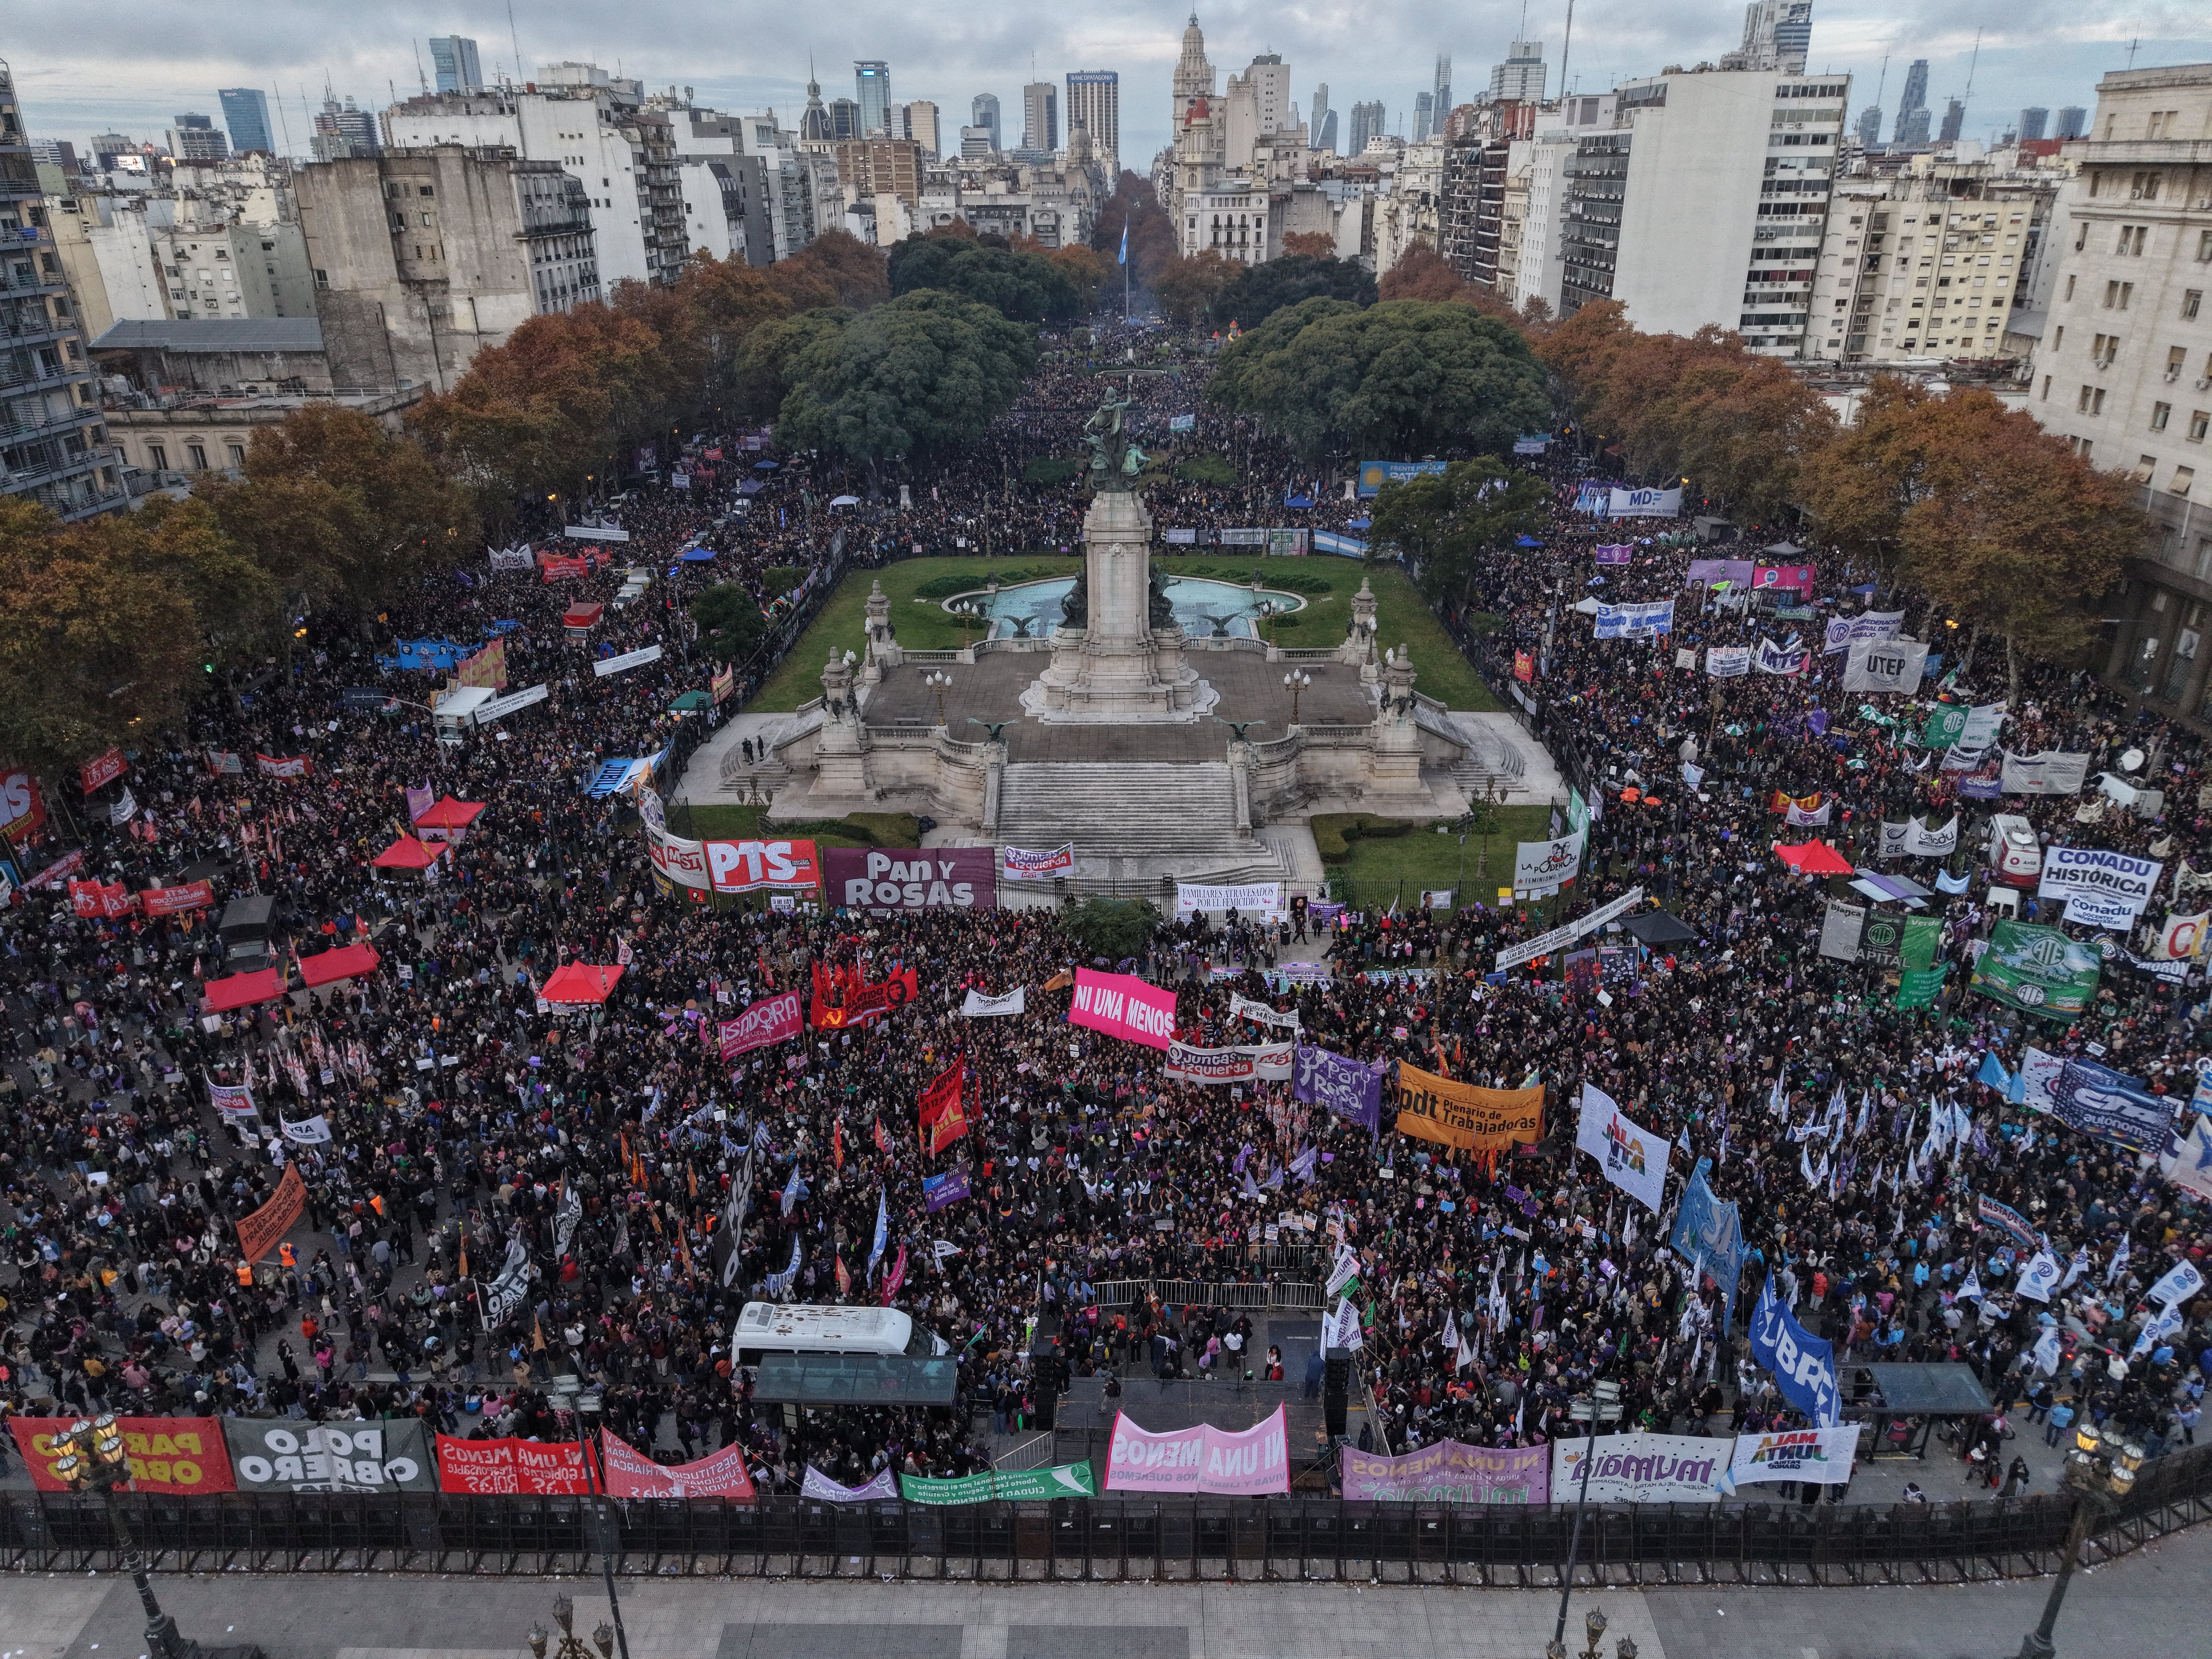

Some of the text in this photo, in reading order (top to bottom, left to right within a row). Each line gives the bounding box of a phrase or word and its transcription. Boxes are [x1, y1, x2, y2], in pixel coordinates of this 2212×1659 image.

[1867, 655, 1906, 676] UTEP
[1945, 713, 1963, 731] ATE
[669, 848, 699, 868] MST
[707, 841, 797, 883] PTS
[1014, 855, 1067, 872] izquierda
[1534, 853, 1577, 875] PODEROSA
[2057, 850, 2151, 876] CONADU
[937, 860, 956, 880] Y
[1525, 873, 1556, 884] FEMINISMO
[2045, 866, 2147, 895] HISTÓRICA
[845, 877, 975, 907] ROSAS
[1182, 886, 1274, 898] FAMILIARES ATRAVESADOS
[1197, 897, 1259, 907] POR EL FEMICIDIO
[1593, 907, 1610, 921] FEMINISTAS
[1831, 904, 1862, 917] Blanca
[2071, 898, 2132, 915] Conadu
[1870, 913, 1900, 923] Negra
[1506, 943, 1527, 954] VIOLENCIA
[1554, 925, 1570, 936] AJUSTAR
[1554, 929, 1571, 941] BARRIADAS
[1871, 927, 1893, 943] ATE
[1506, 955, 1525, 965] QUEREMOS
[1536, 945, 1548, 955] LIBRES
[1843, 945, 1911, 969] CAPITAL
[2033, 940, 2062, 966] ATE
[2019, 986, 2043, 1004] ATE
[721, 995, 799, 1045] ISADORA
[1074, 984, 1175, 1039] NI UNA MENOS
[1242, 1005, 1254, 1015] ME
[723, 1038, 741, 1052] MUJERES
[726, 1045, 748, 1056] IZQUIERDA
[1180, 1061, 1248, 1075] izquierda
[1261, 1053, 1291, 1064] MST
[1327, 1060, 1371, 1096] Pan y
[1398, 1088, 1439, 1119] pdt
[1443, 1098, 1502, 1120] Plenario de
[1442, 1108, 1536, 1136] Trabajadoras
[2082, 1114, 2153, 1138] autónoma
[934, 1187, 960, 1202] hacemos fuertes
[937, 1184, 949, 1195] juntas
[1982, 1198, 2019, 1222] BASTA DE
